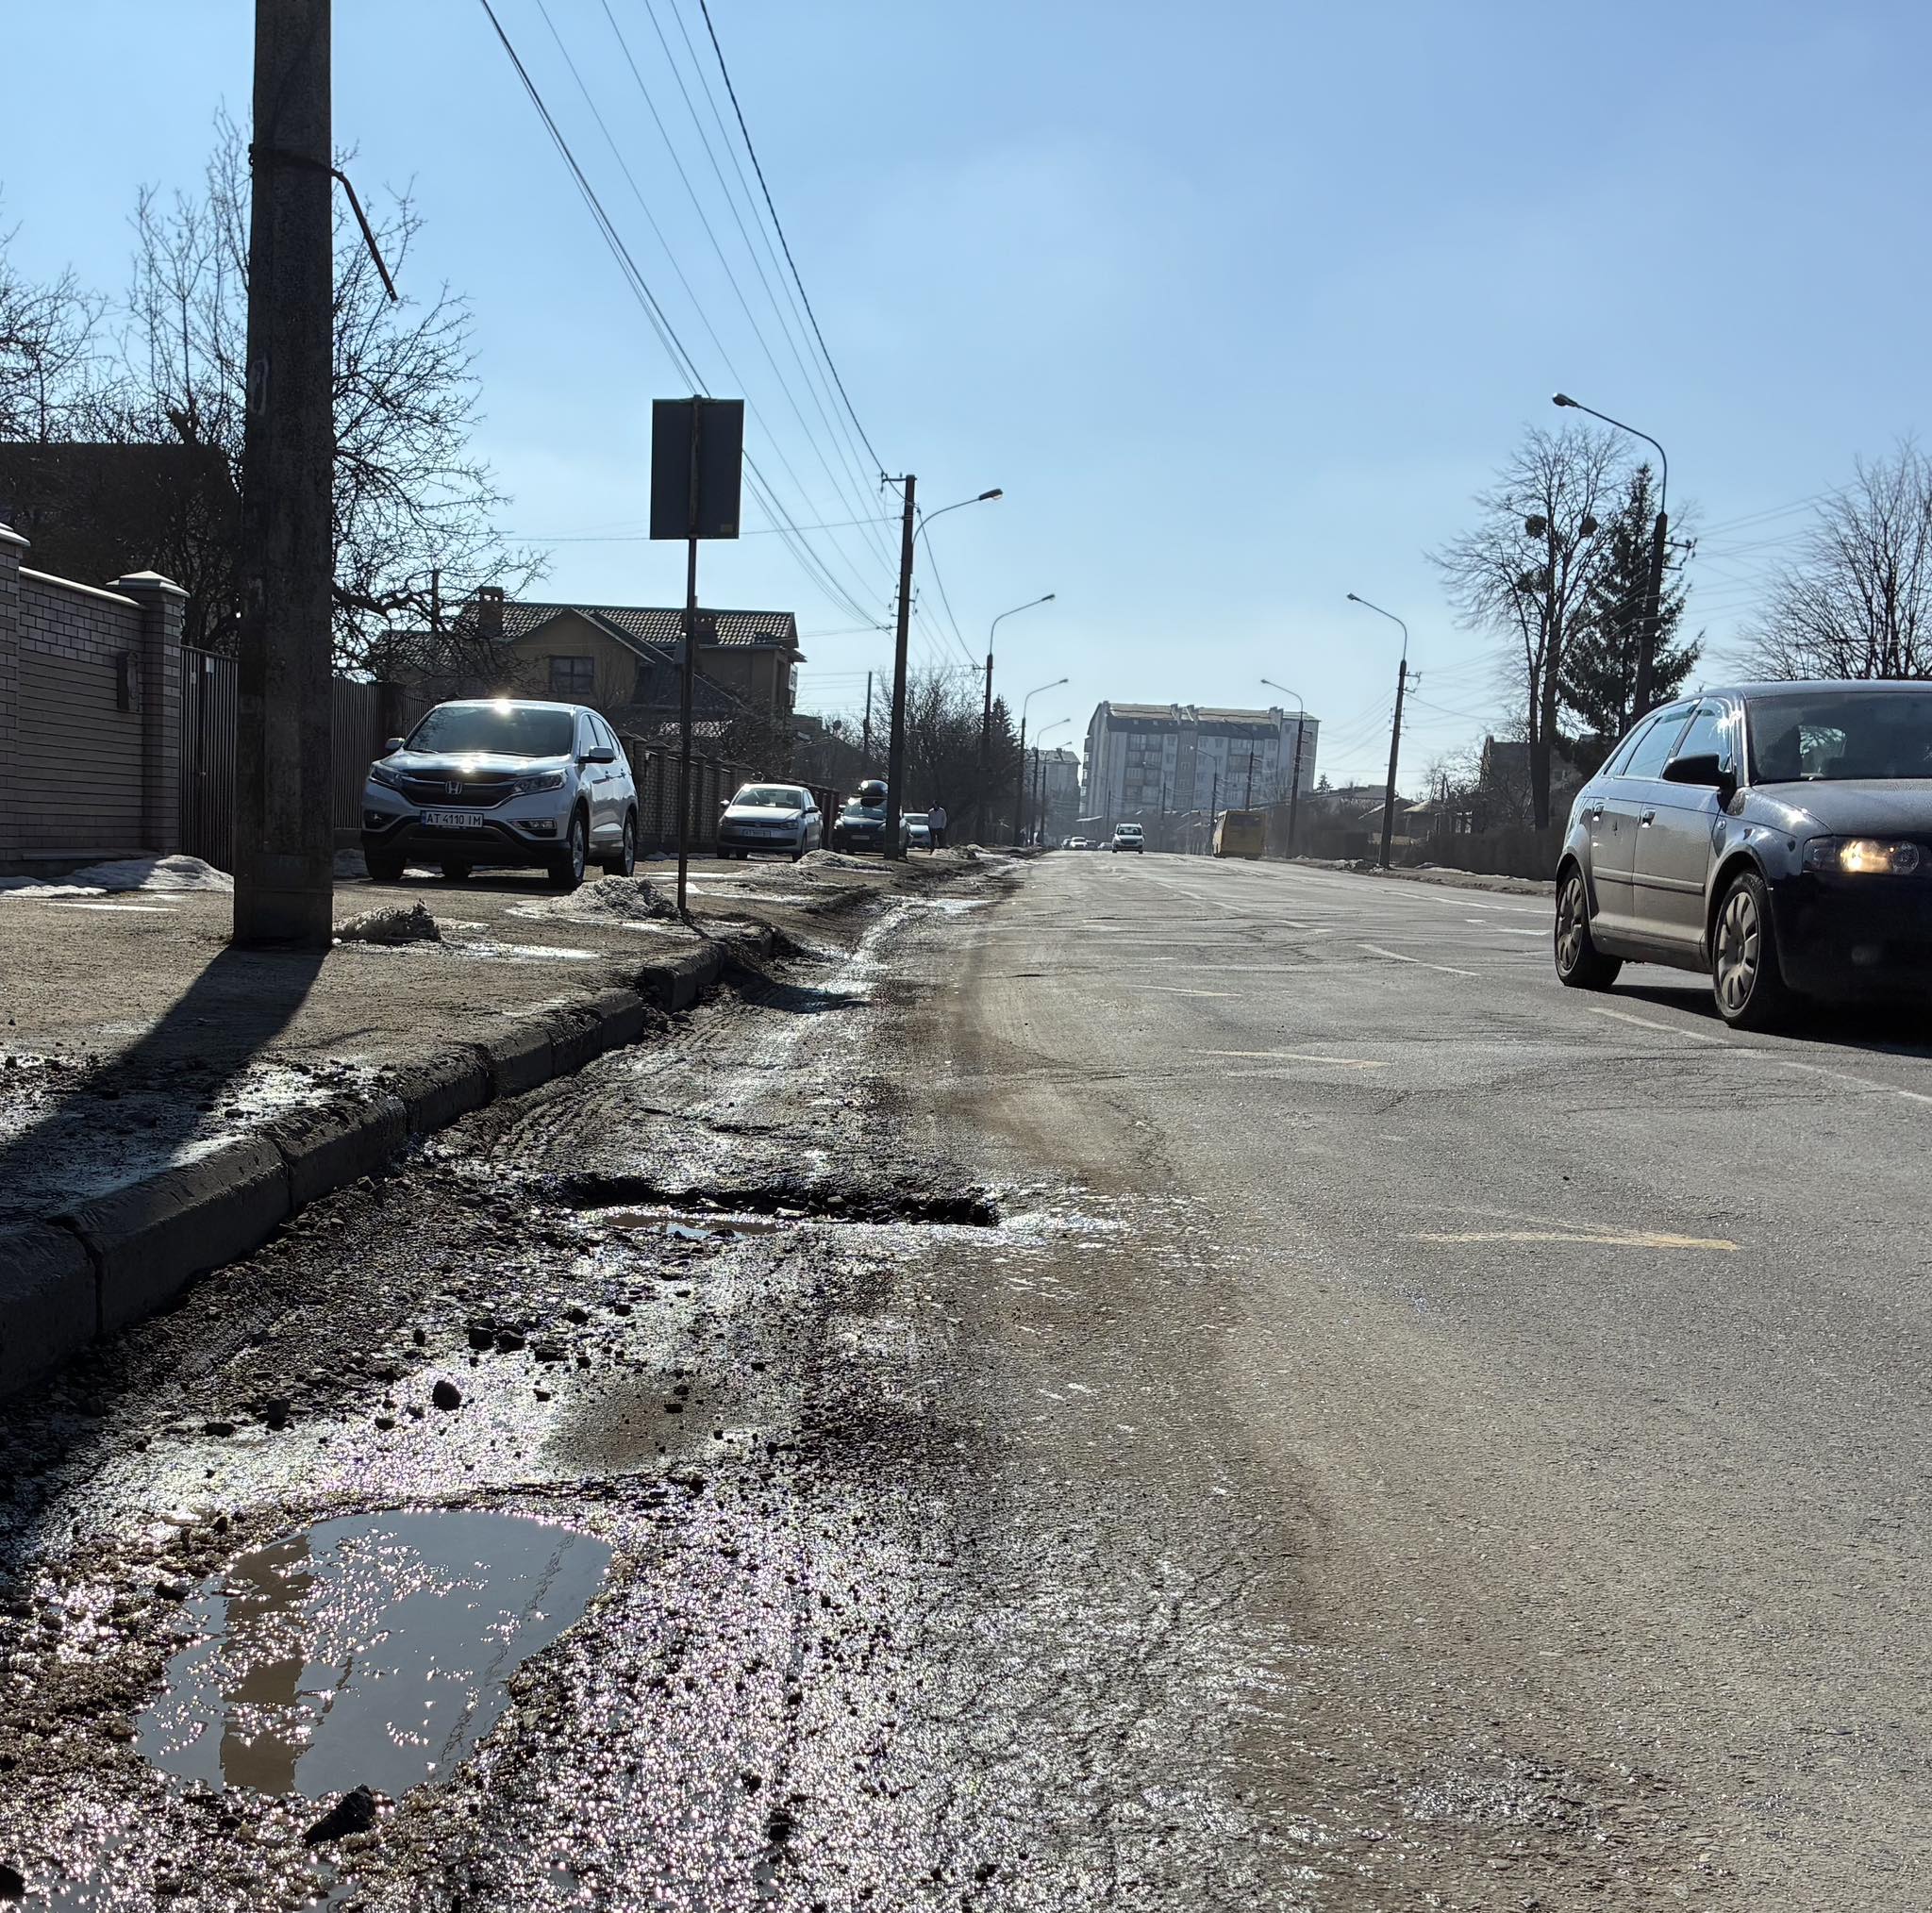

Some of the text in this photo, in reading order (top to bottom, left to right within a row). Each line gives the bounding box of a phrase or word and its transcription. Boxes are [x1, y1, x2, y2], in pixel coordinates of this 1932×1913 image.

[426, 813, 481, 826] AT 4110 IM
